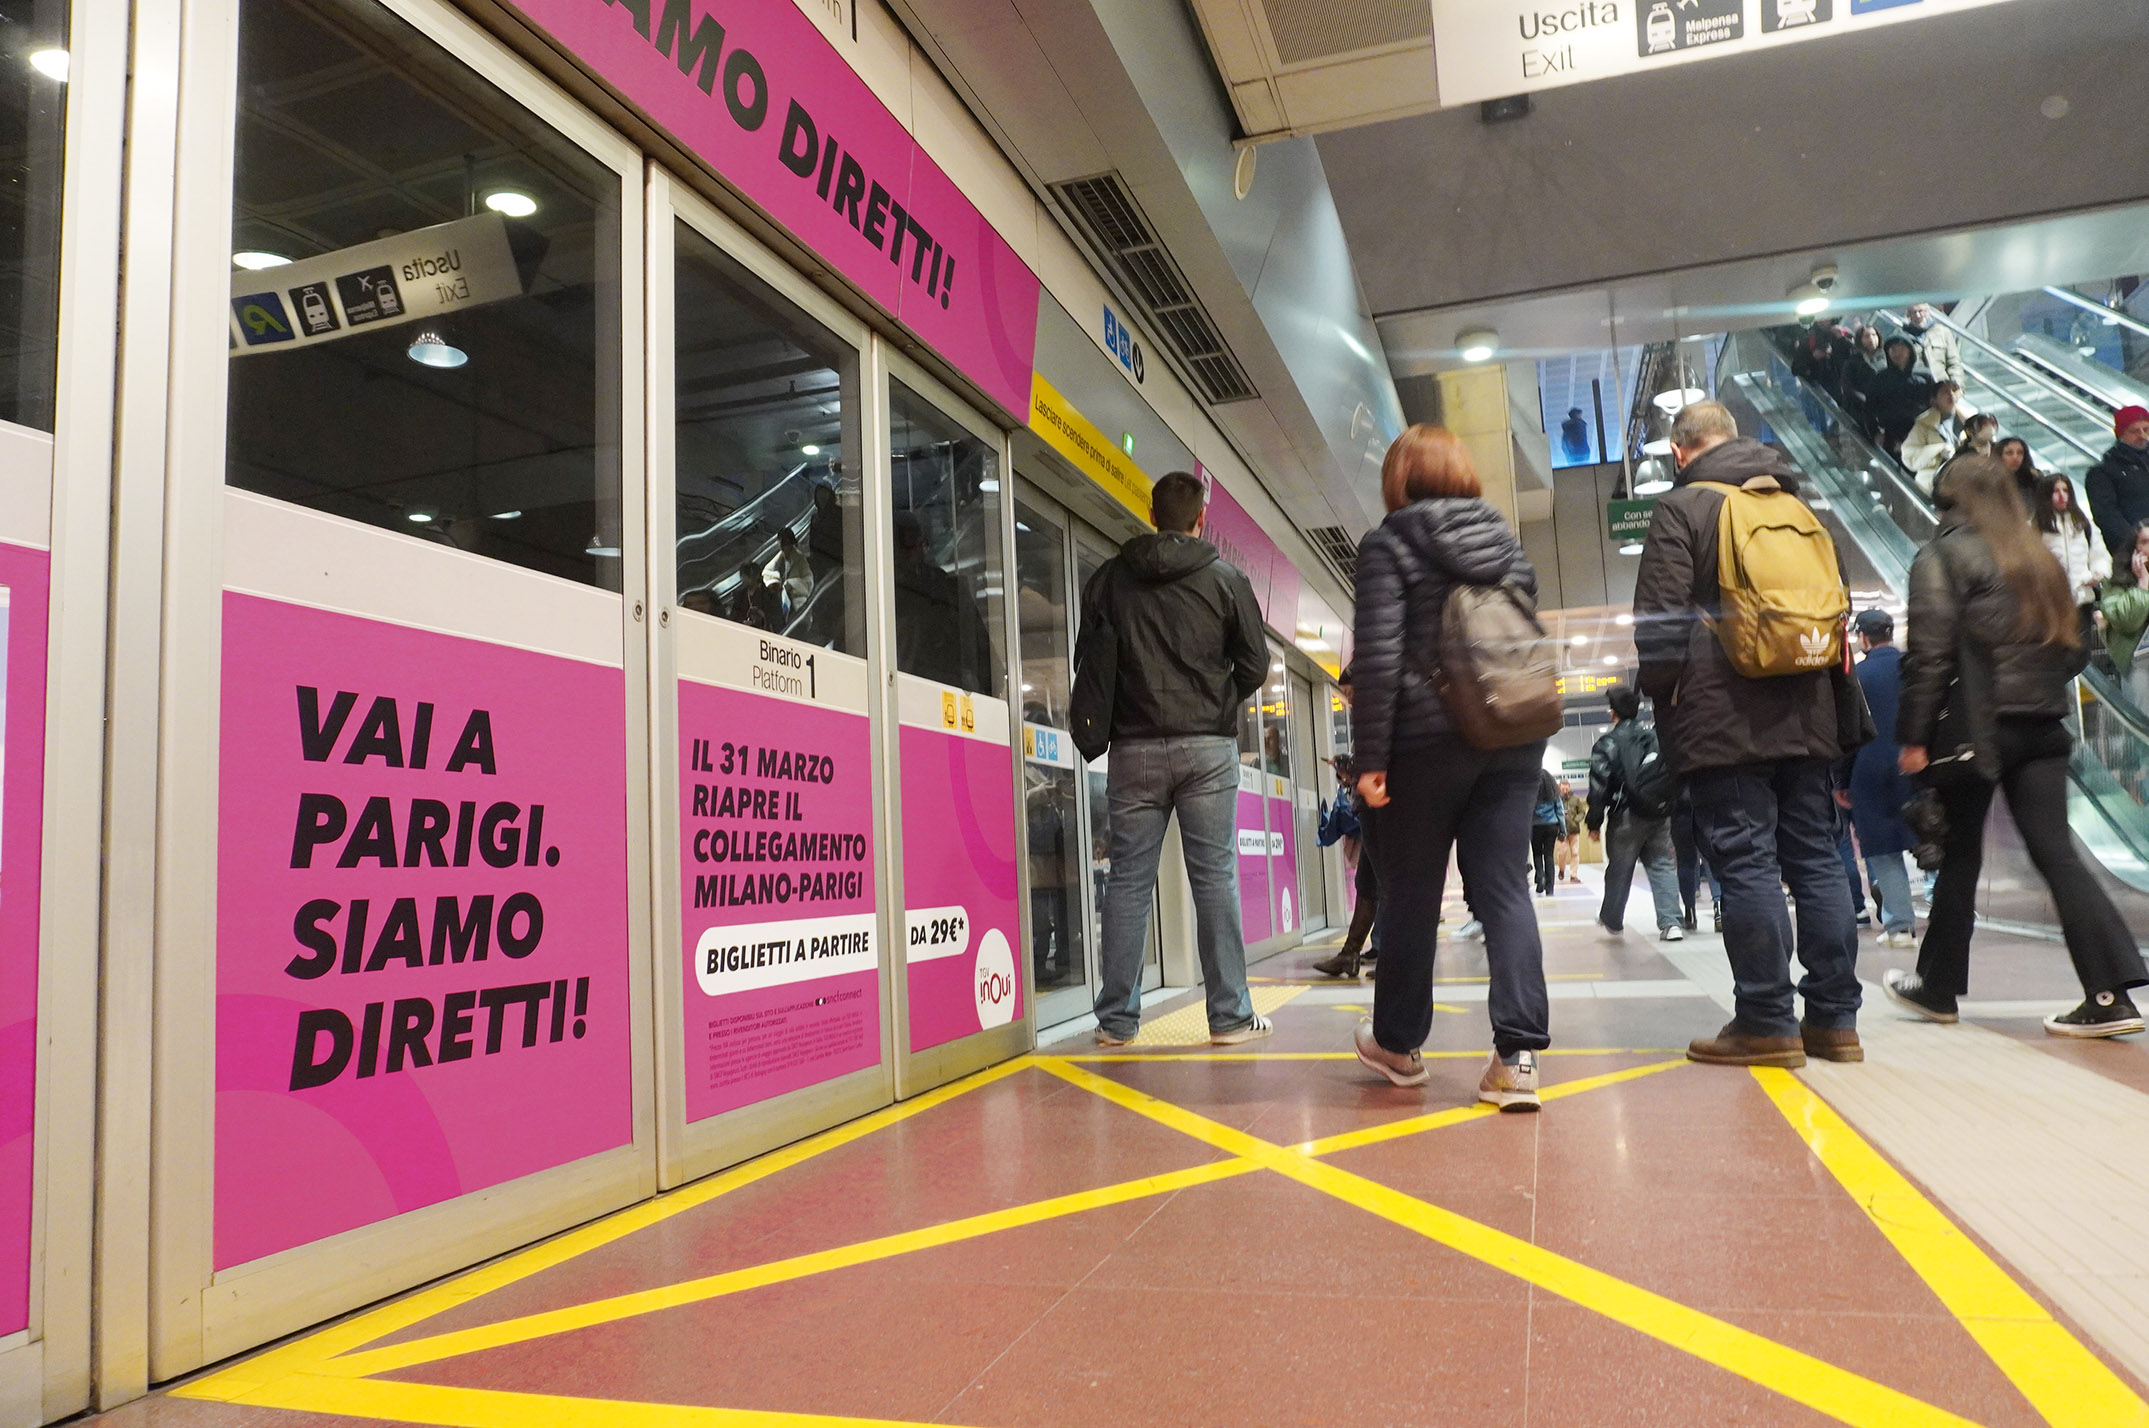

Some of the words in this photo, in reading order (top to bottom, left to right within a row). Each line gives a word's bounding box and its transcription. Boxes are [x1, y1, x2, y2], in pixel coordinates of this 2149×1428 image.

[1518, 0, 1619, 40] Uscita
[1685, 11, 1739, 32] Malpensa
[1686, 27, 1731, 45] Express
[1521, 43, 1575, 78] Exit
[778, 97, 956, 310] DIRETTI!
[1034, 393, 1062, 430] Lasciare
[1062, 418, 1090, 455] scendere
[1612, 519, 1650, 531] abbando
[1624, 511, 1642, 521] Con
[1642, 510, 1653, 519] se
[752, 665, 802, 696] Platform
[760, 640, 801, 669] Binario
[806, 654, 815, 698] 1
[296, 685, 434, 769] VAI
[445, 709, 496, 775] A
[692, 739, 713, 772] IL
[720, 742, 748, 775] 31
[757, 748, 834, 784] MARZO
[692, 784, 779, 819] RIAPRE
[785, 792, 802, 821] IL
[290, 793, 560, 868] PARIGI.
[693, 829, 866, 862] COLLEGAMENTO
[694, 872, 863, 908] MILANO-PARIGI
[284, 892, 543, 979] SIAMO
[706, 940, 790, 975] BIGLIETTI
[795, 939, 806, 961] A
[810, 931, 869, 960] PARTIRE
[910, 925, 927, 945] DA
[979, 967, 990, 979] TGV
[289, 976, 589, 1091] DIRETTI!
